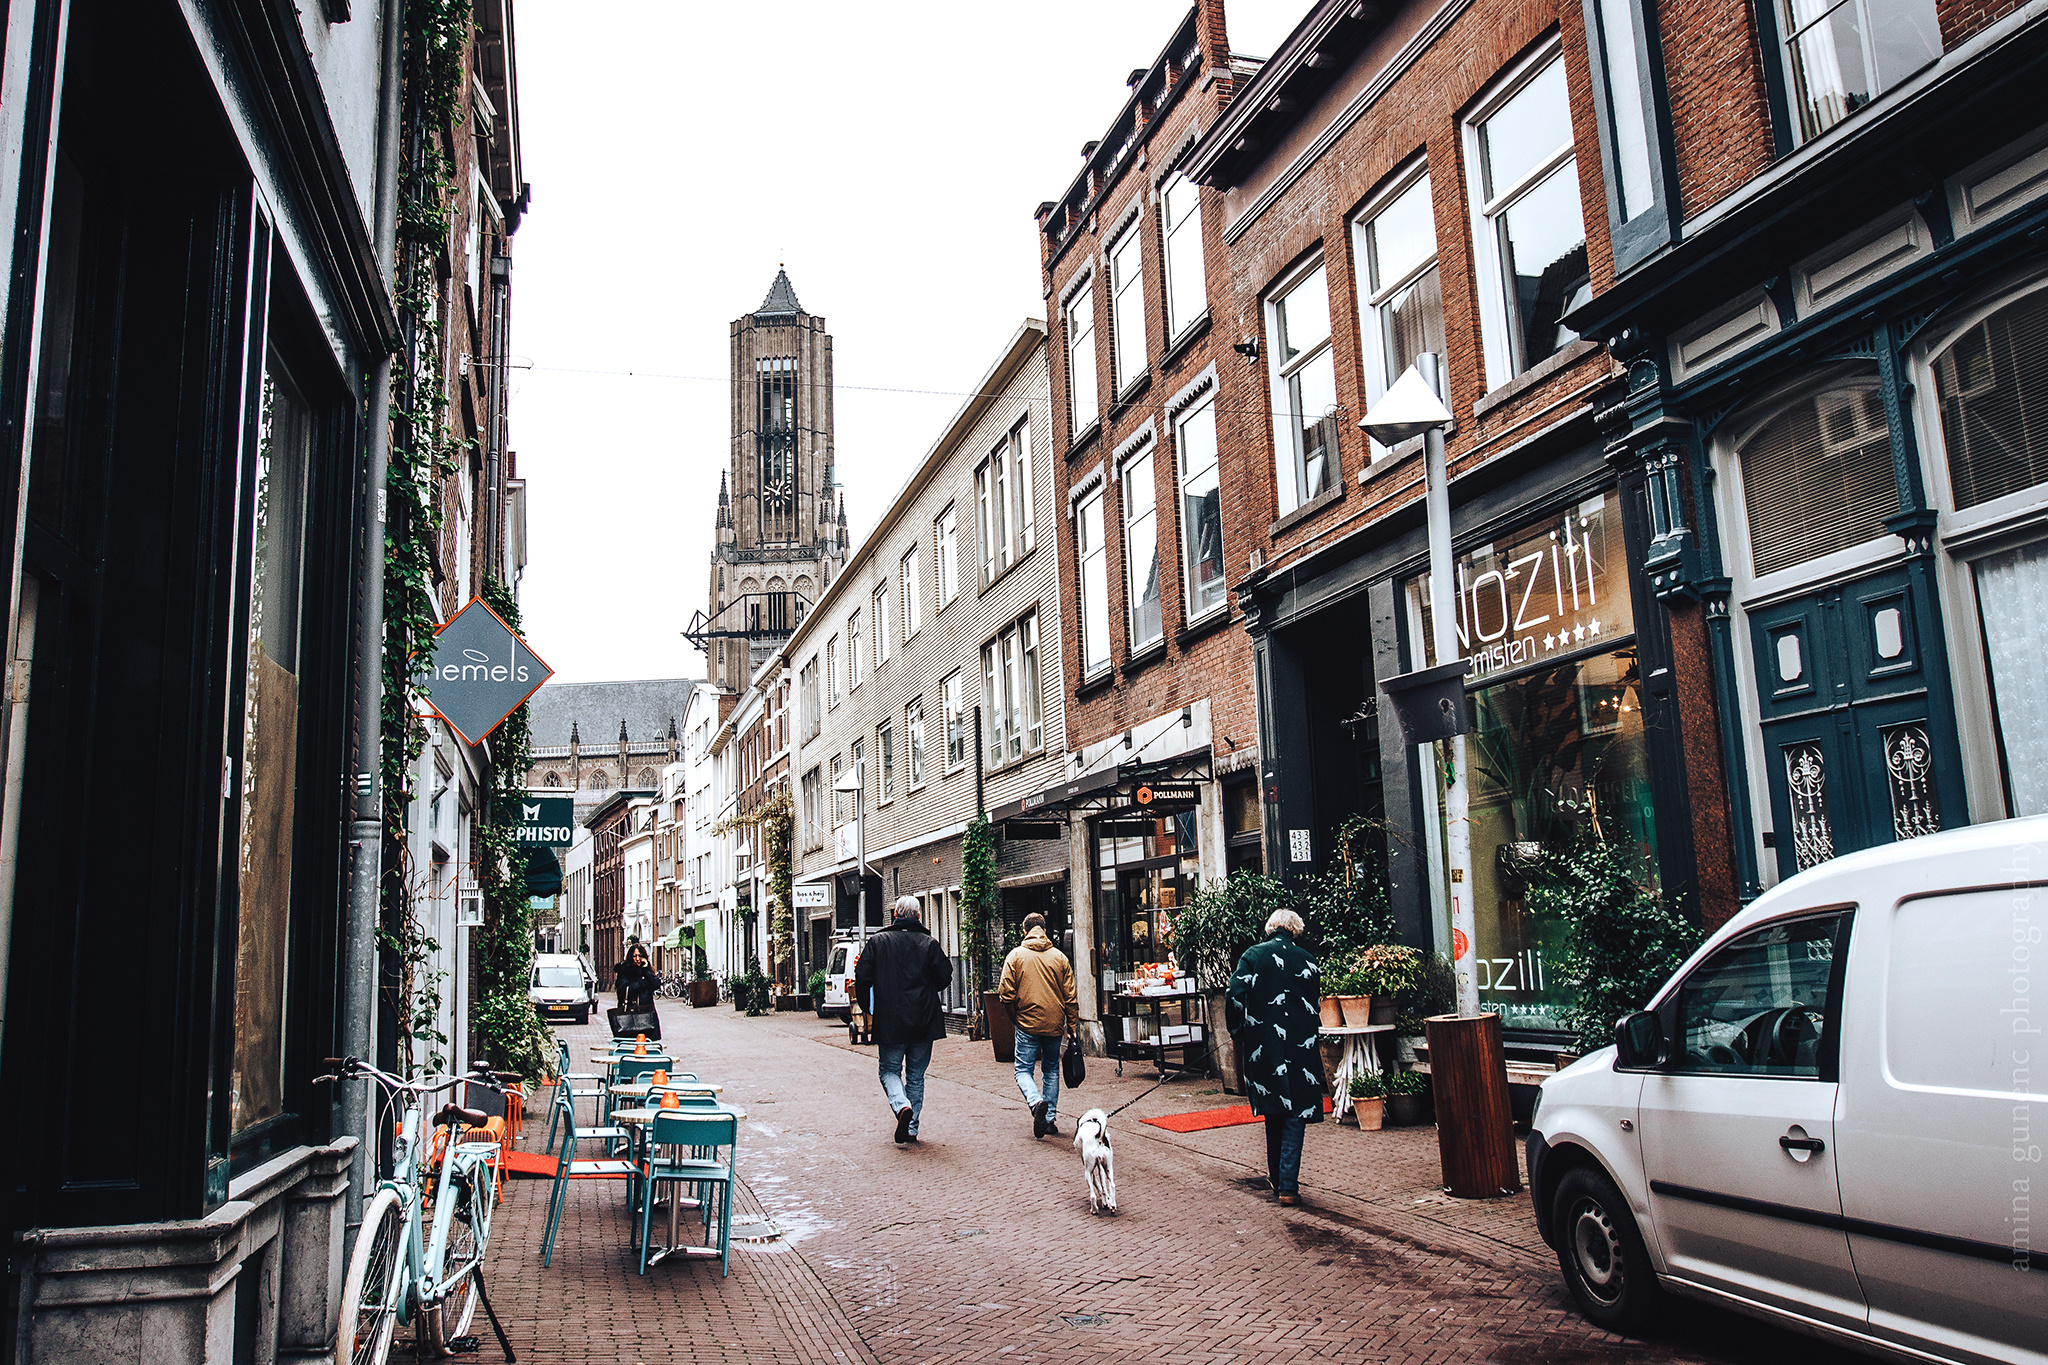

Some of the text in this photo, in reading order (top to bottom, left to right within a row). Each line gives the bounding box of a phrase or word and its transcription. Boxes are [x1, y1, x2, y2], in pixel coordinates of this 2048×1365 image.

[1153, 790, 1194, 799] POLLMANN
[507, 826, 571, 842] EPHISTO
[1476, 948, 1544, 991] ozili
